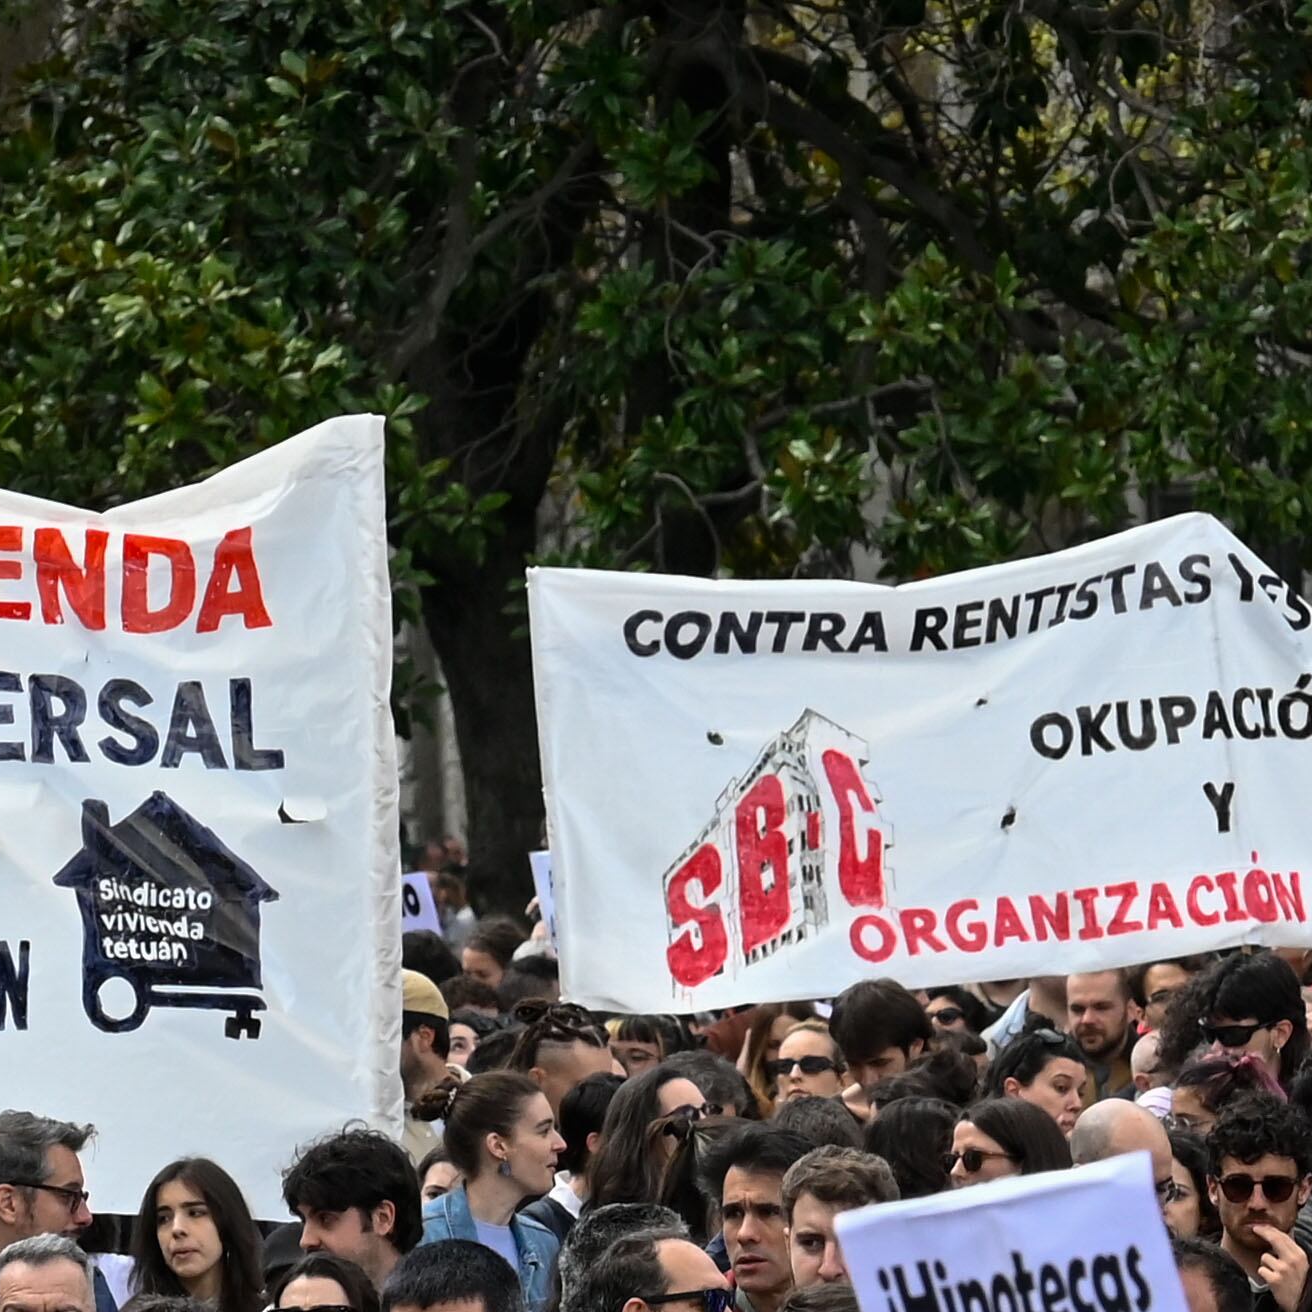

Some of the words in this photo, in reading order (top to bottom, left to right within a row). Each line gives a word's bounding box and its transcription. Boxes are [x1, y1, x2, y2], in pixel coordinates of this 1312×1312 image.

[623, 609, 889, 661] CONTRA
[909, 553, 1212, 652] RENTISTAS
[1202, 781, 1236, 834] Y
[100, 905, 205, 941] vivienda
[849, 850, 1306, 964] ORGANIZACIÓN
[102, 936, 188, 962] tetuán
